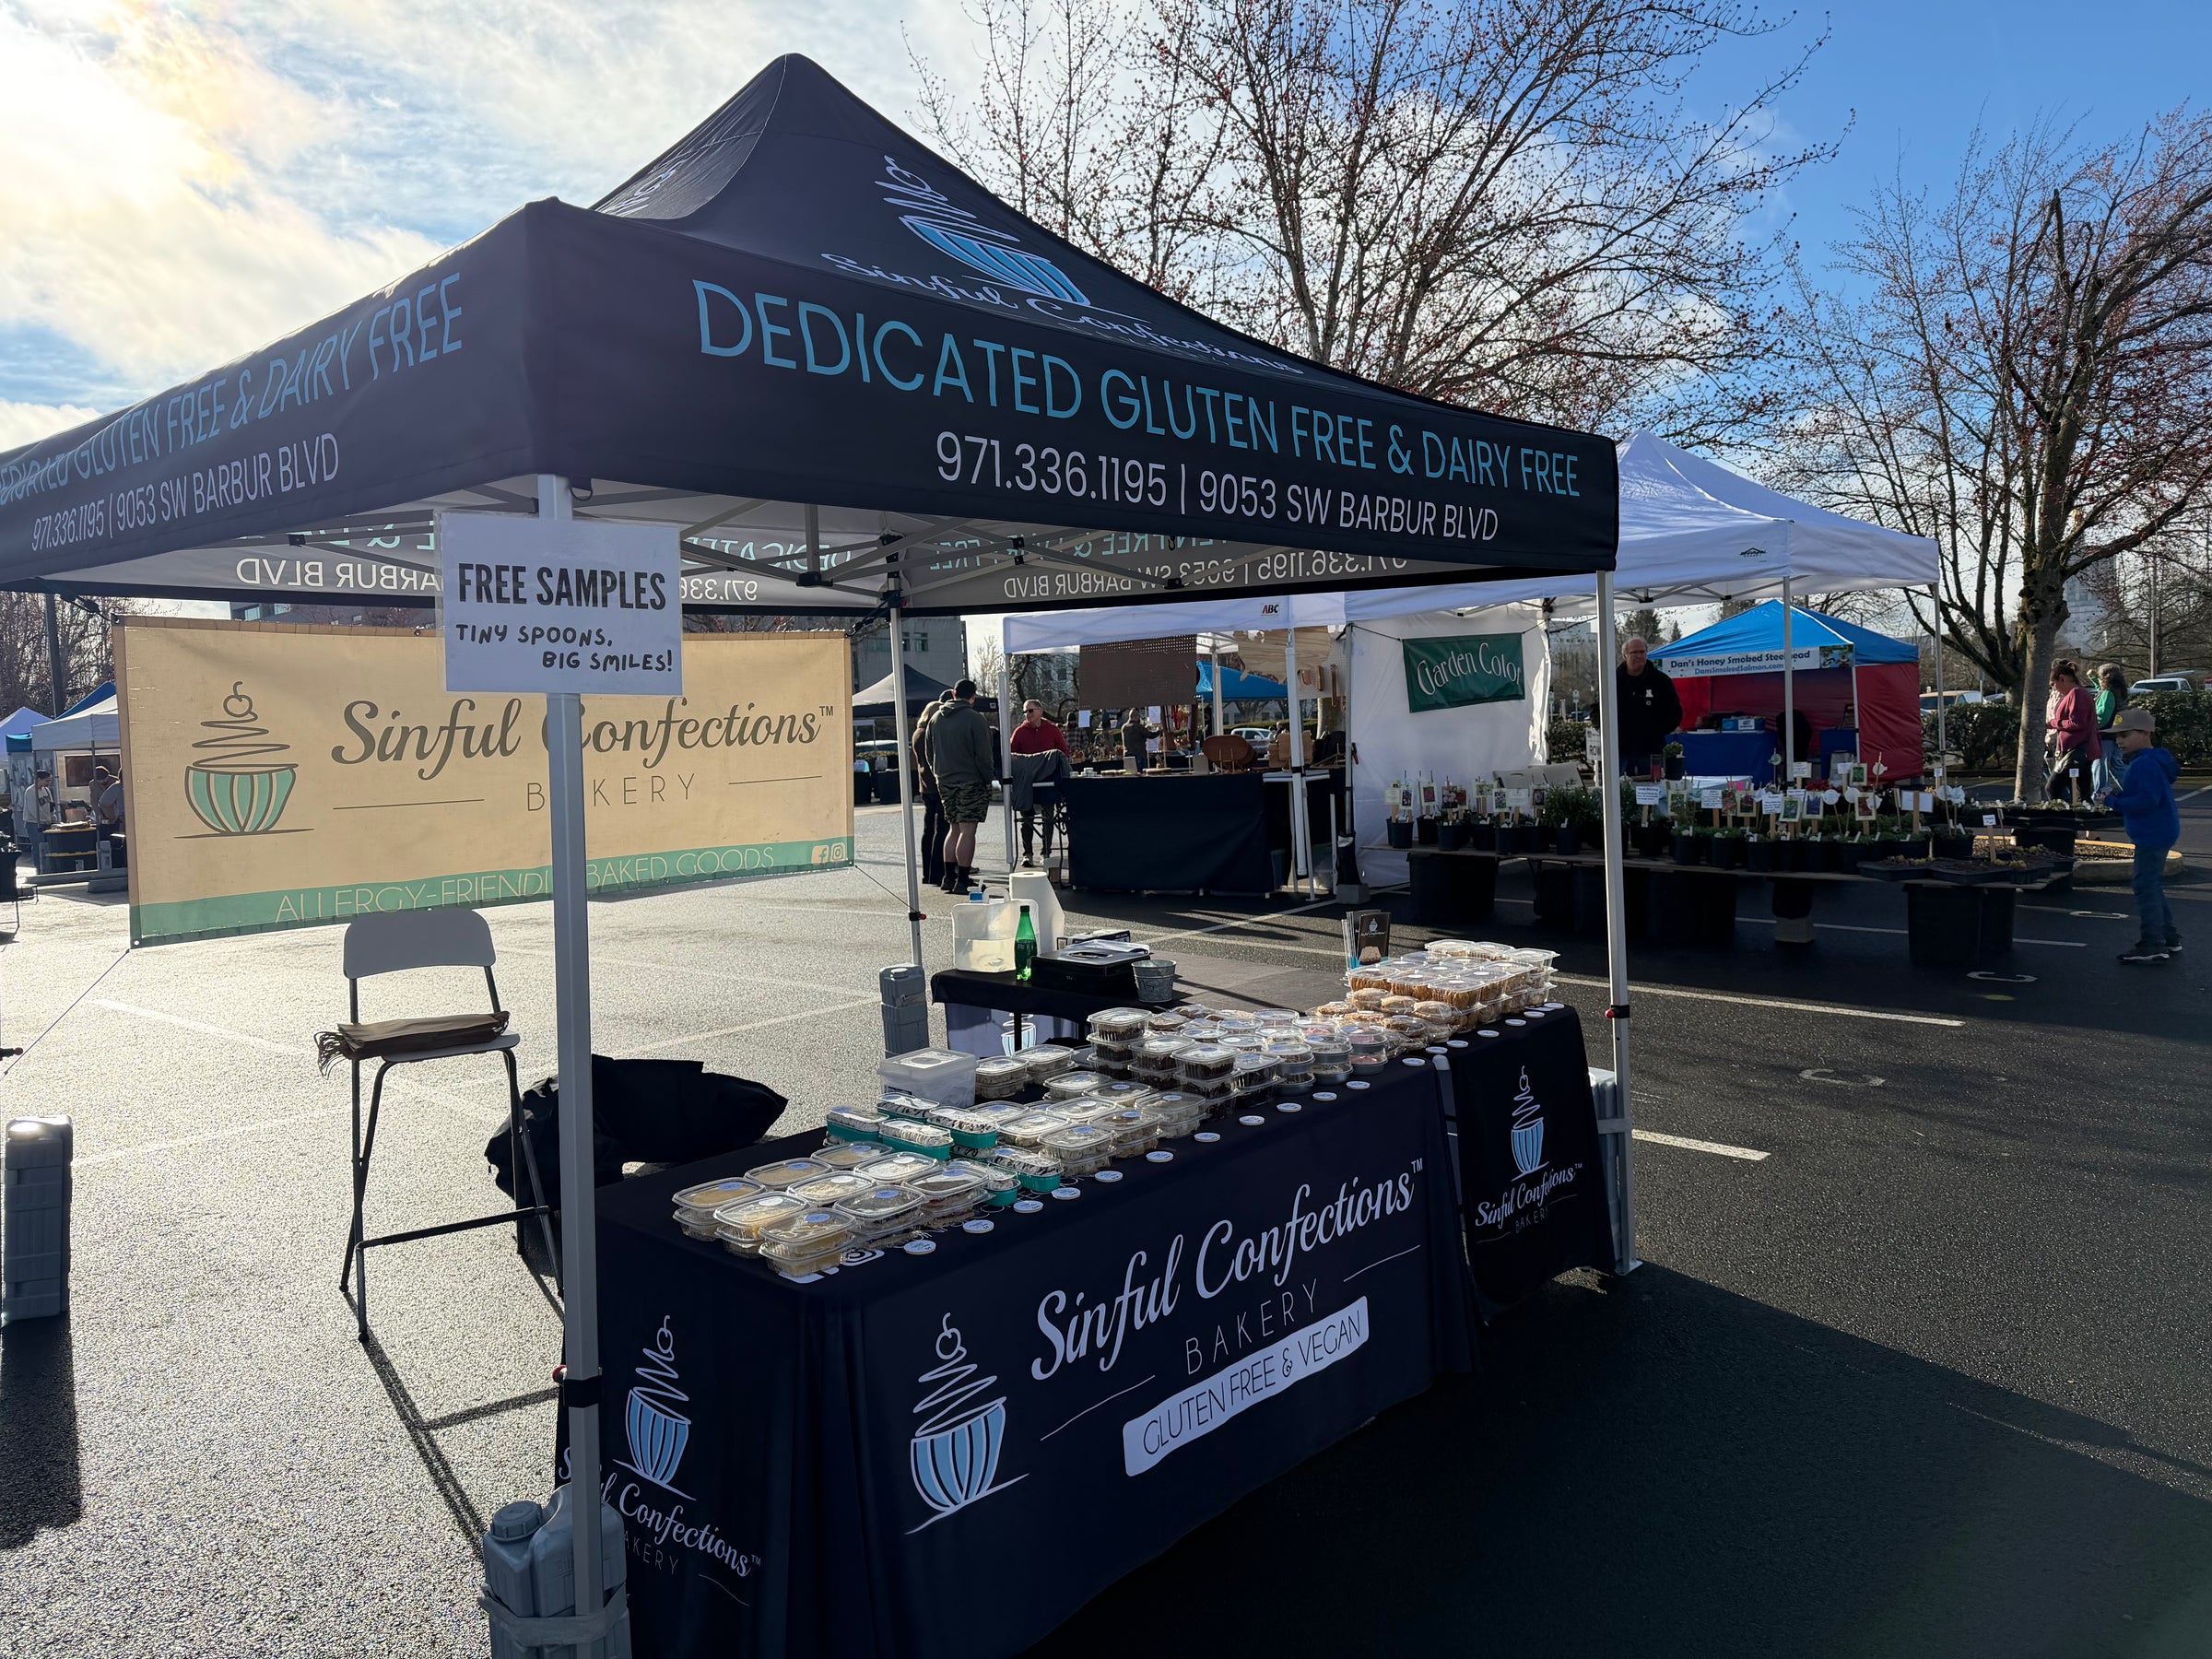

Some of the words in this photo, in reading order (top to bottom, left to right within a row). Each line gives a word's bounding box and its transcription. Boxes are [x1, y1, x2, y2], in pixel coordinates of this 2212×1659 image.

[821, 253, 1019, 310] Sinful
[1029, 298, 1305, 375] Confections
[75, 404, 160, 479] GLUTEN
[167, 378, 228, 453] FREE
[230, 369, 254, 429] &
[257, 319, 363, 419] DAIRY
[369, 272, 462, 381] FREE
[692, 279, 1082, 418] DEDICATED
[1100, 369, 1278, 453] GLUTEN
[1290, 406, 1377, 469] FREE
[1387, 424, 1414, 476] &
[1422, 430, 1511, 488] DAIRY
[1521, 447, 1581, 497] FREE
[31, 499, 105, 552] 971.336.1195
[117, 483, 157, 532] 9053
[160, 475, 187, 522] SW
[193, 452, 273, 514] BARBUR
[278, 432, 339, 492] BLVD
[936, 430, 1167, 506] 971.336.1195
[1199, 470, 1277, 519] 9053
[1287, 484, 1332, 525] SW
[1339, 491, 1438, 535] BARBUR
[1444, 504, 1499, 541] BLVD
[458, 563, 528, 605] FREE
[536, 567, 666, 610] SAMPLES
[1262, 604, 1279, 614] ABC
[455, 624, 508, 644] TINY
[517, 625, 613, 647] SPOONS,
[542, 651, 581, 670] BIG
[590, 649, 673, 672] SMILES!
[1670, 659, 1695, 669] Dan's
[1697, 657, 1725, 668] Honey
[1727, 653, 1763, 664] Smoked
[1765, 650, 1810, 662] Steeead
[1417, 651, 1477, 696] Garden
[331, 698, 522, 781] Sinful
[527, 772, 695, 812] BKERY
[586, 856, 668, 890] BAKED
[677, 846, 774, 877] GOODS
[1475, 1186, 1516, 1230] Sinful
[1030, 1233, 1183, 1381] Sinful
[1196, 1171, 1415, 1300] Confections
[1185, 1278, 1317, 1375] BAKERY
[1143, 1382, 1226, 1454] GLUTEN
[1229, 1355, 1277, 1406] FREE
[1282, 1347, 1293, 1378] &
[1298, 1310, 1361, 1367] VEGAN
[618, 1482, 751, 1577] Confections
[623, 1529, 679, 1575] AKERY
